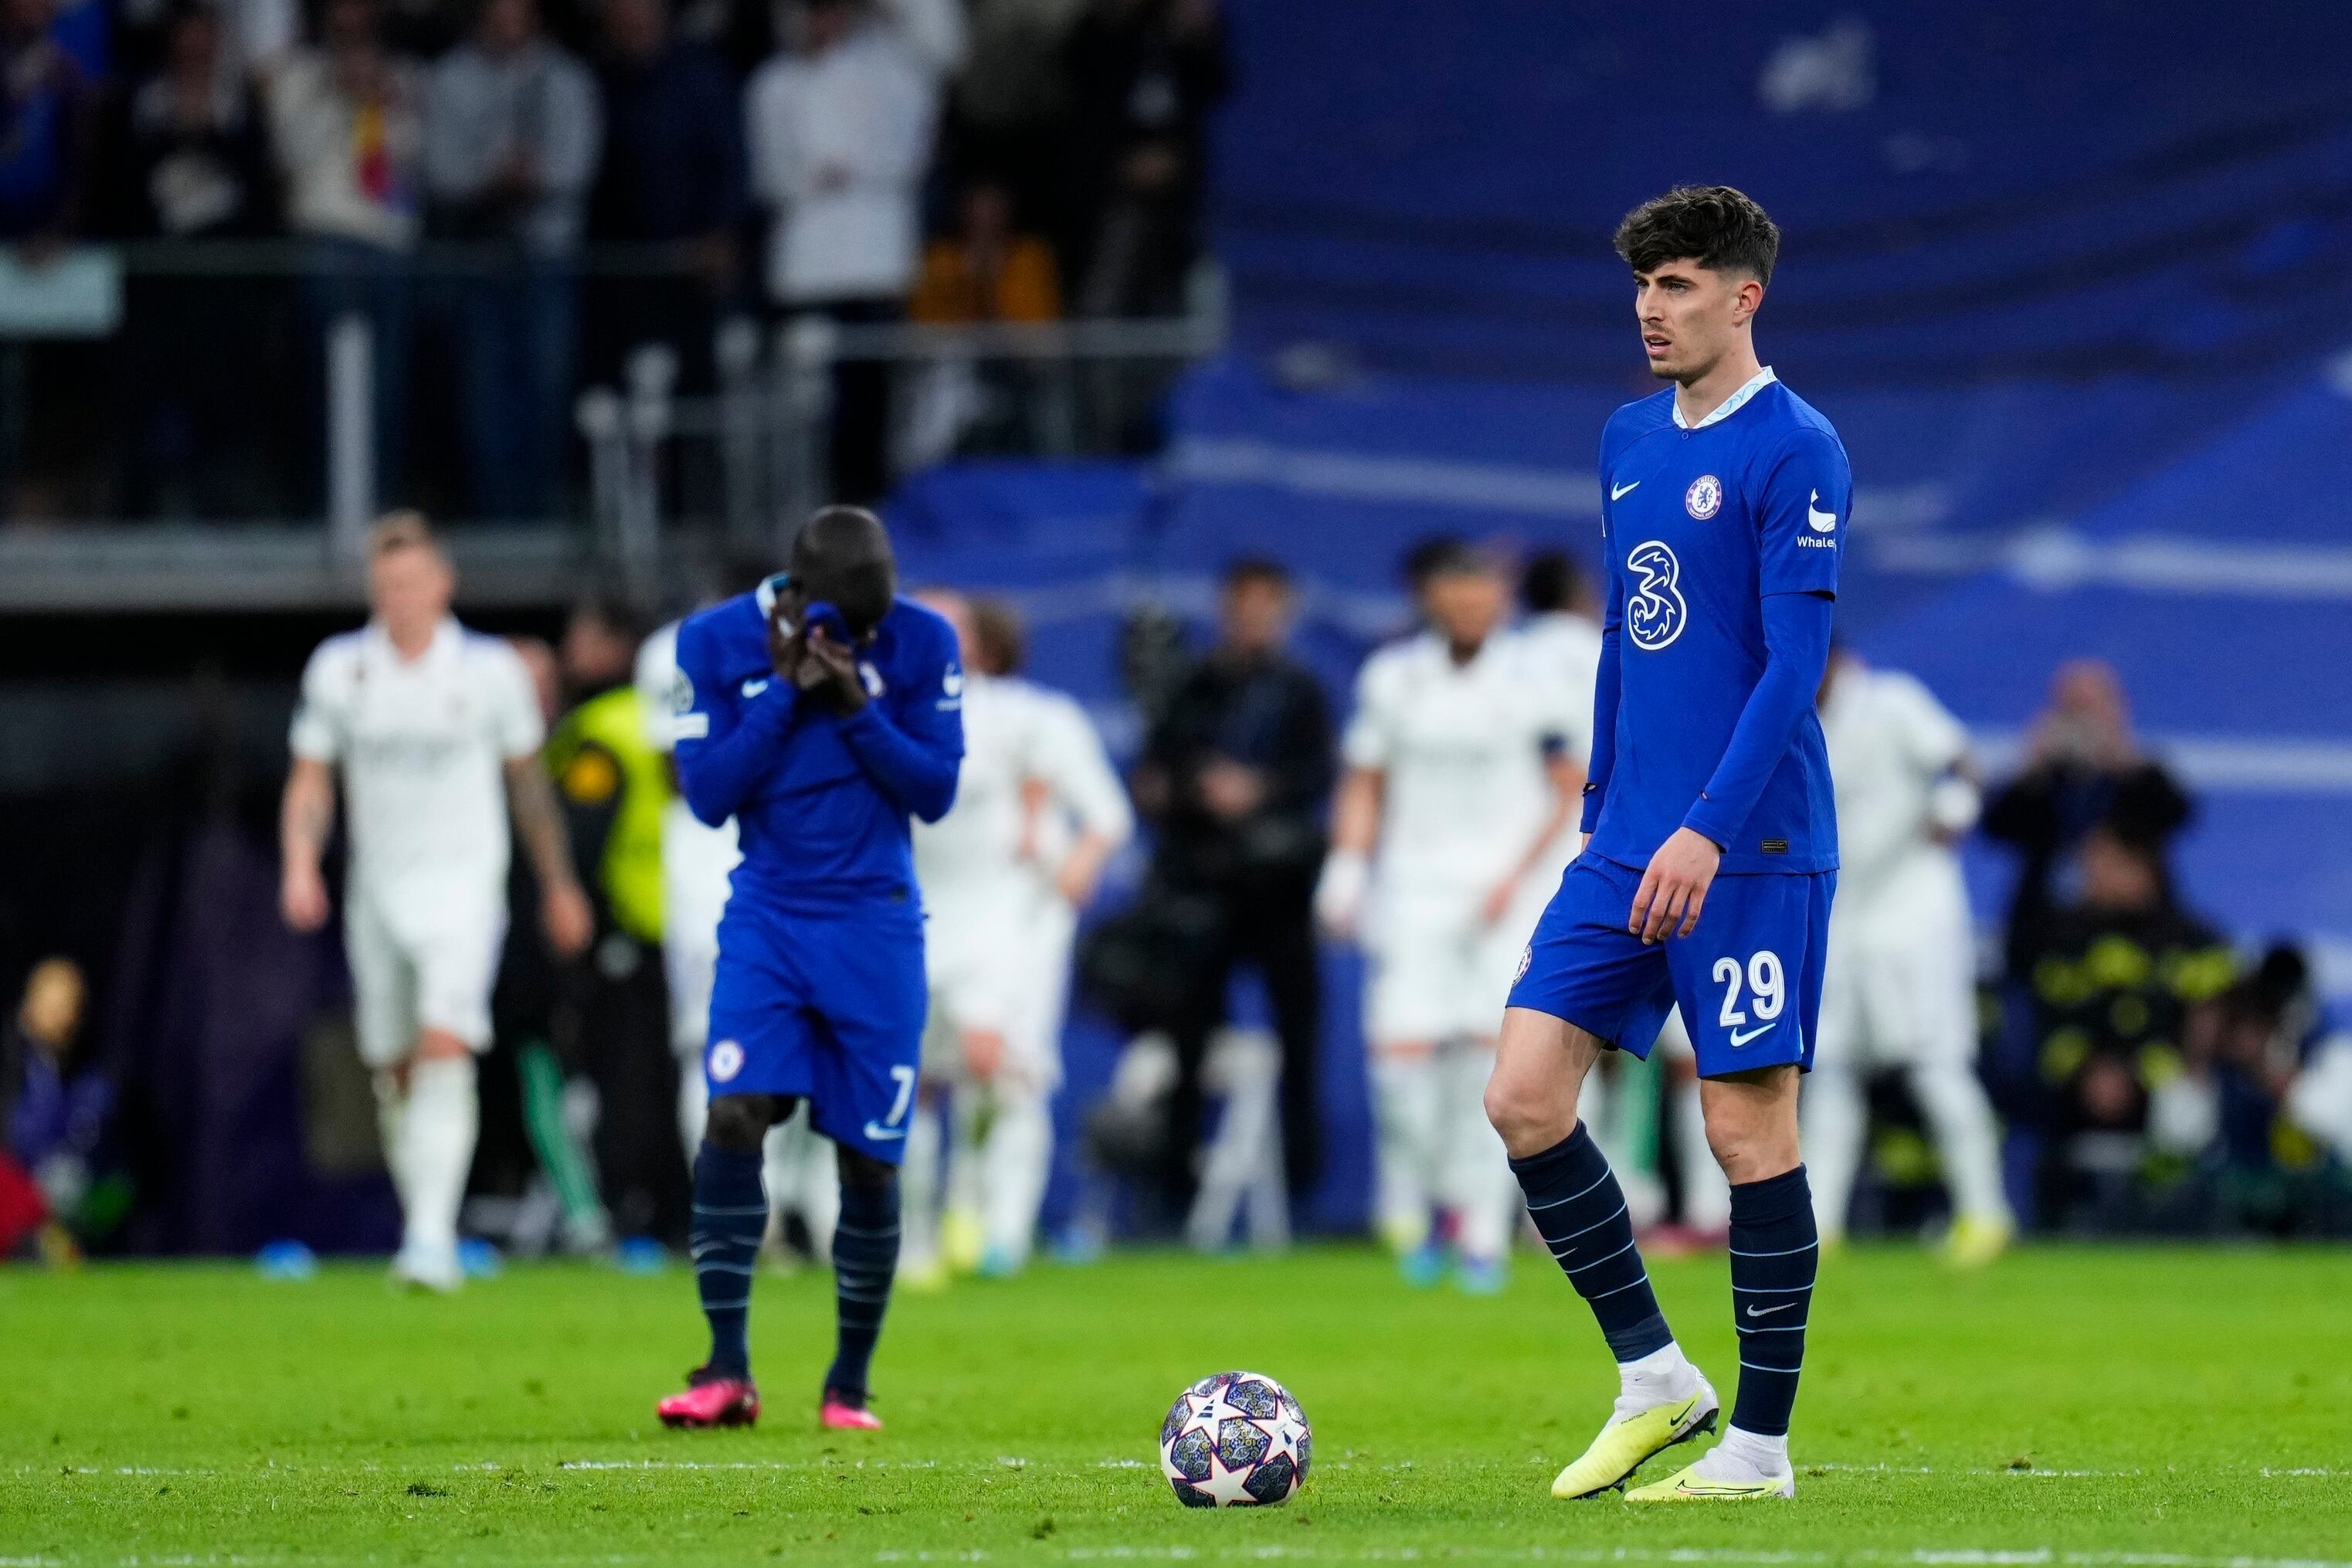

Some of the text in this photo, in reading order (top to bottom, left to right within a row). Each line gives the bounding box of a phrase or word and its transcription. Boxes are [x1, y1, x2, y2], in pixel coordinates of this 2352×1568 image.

[1627, 540, 1687, 651] 3
[1712, 950, 1785, 1027] 29
[885, 1065, 915, 1126] 7
